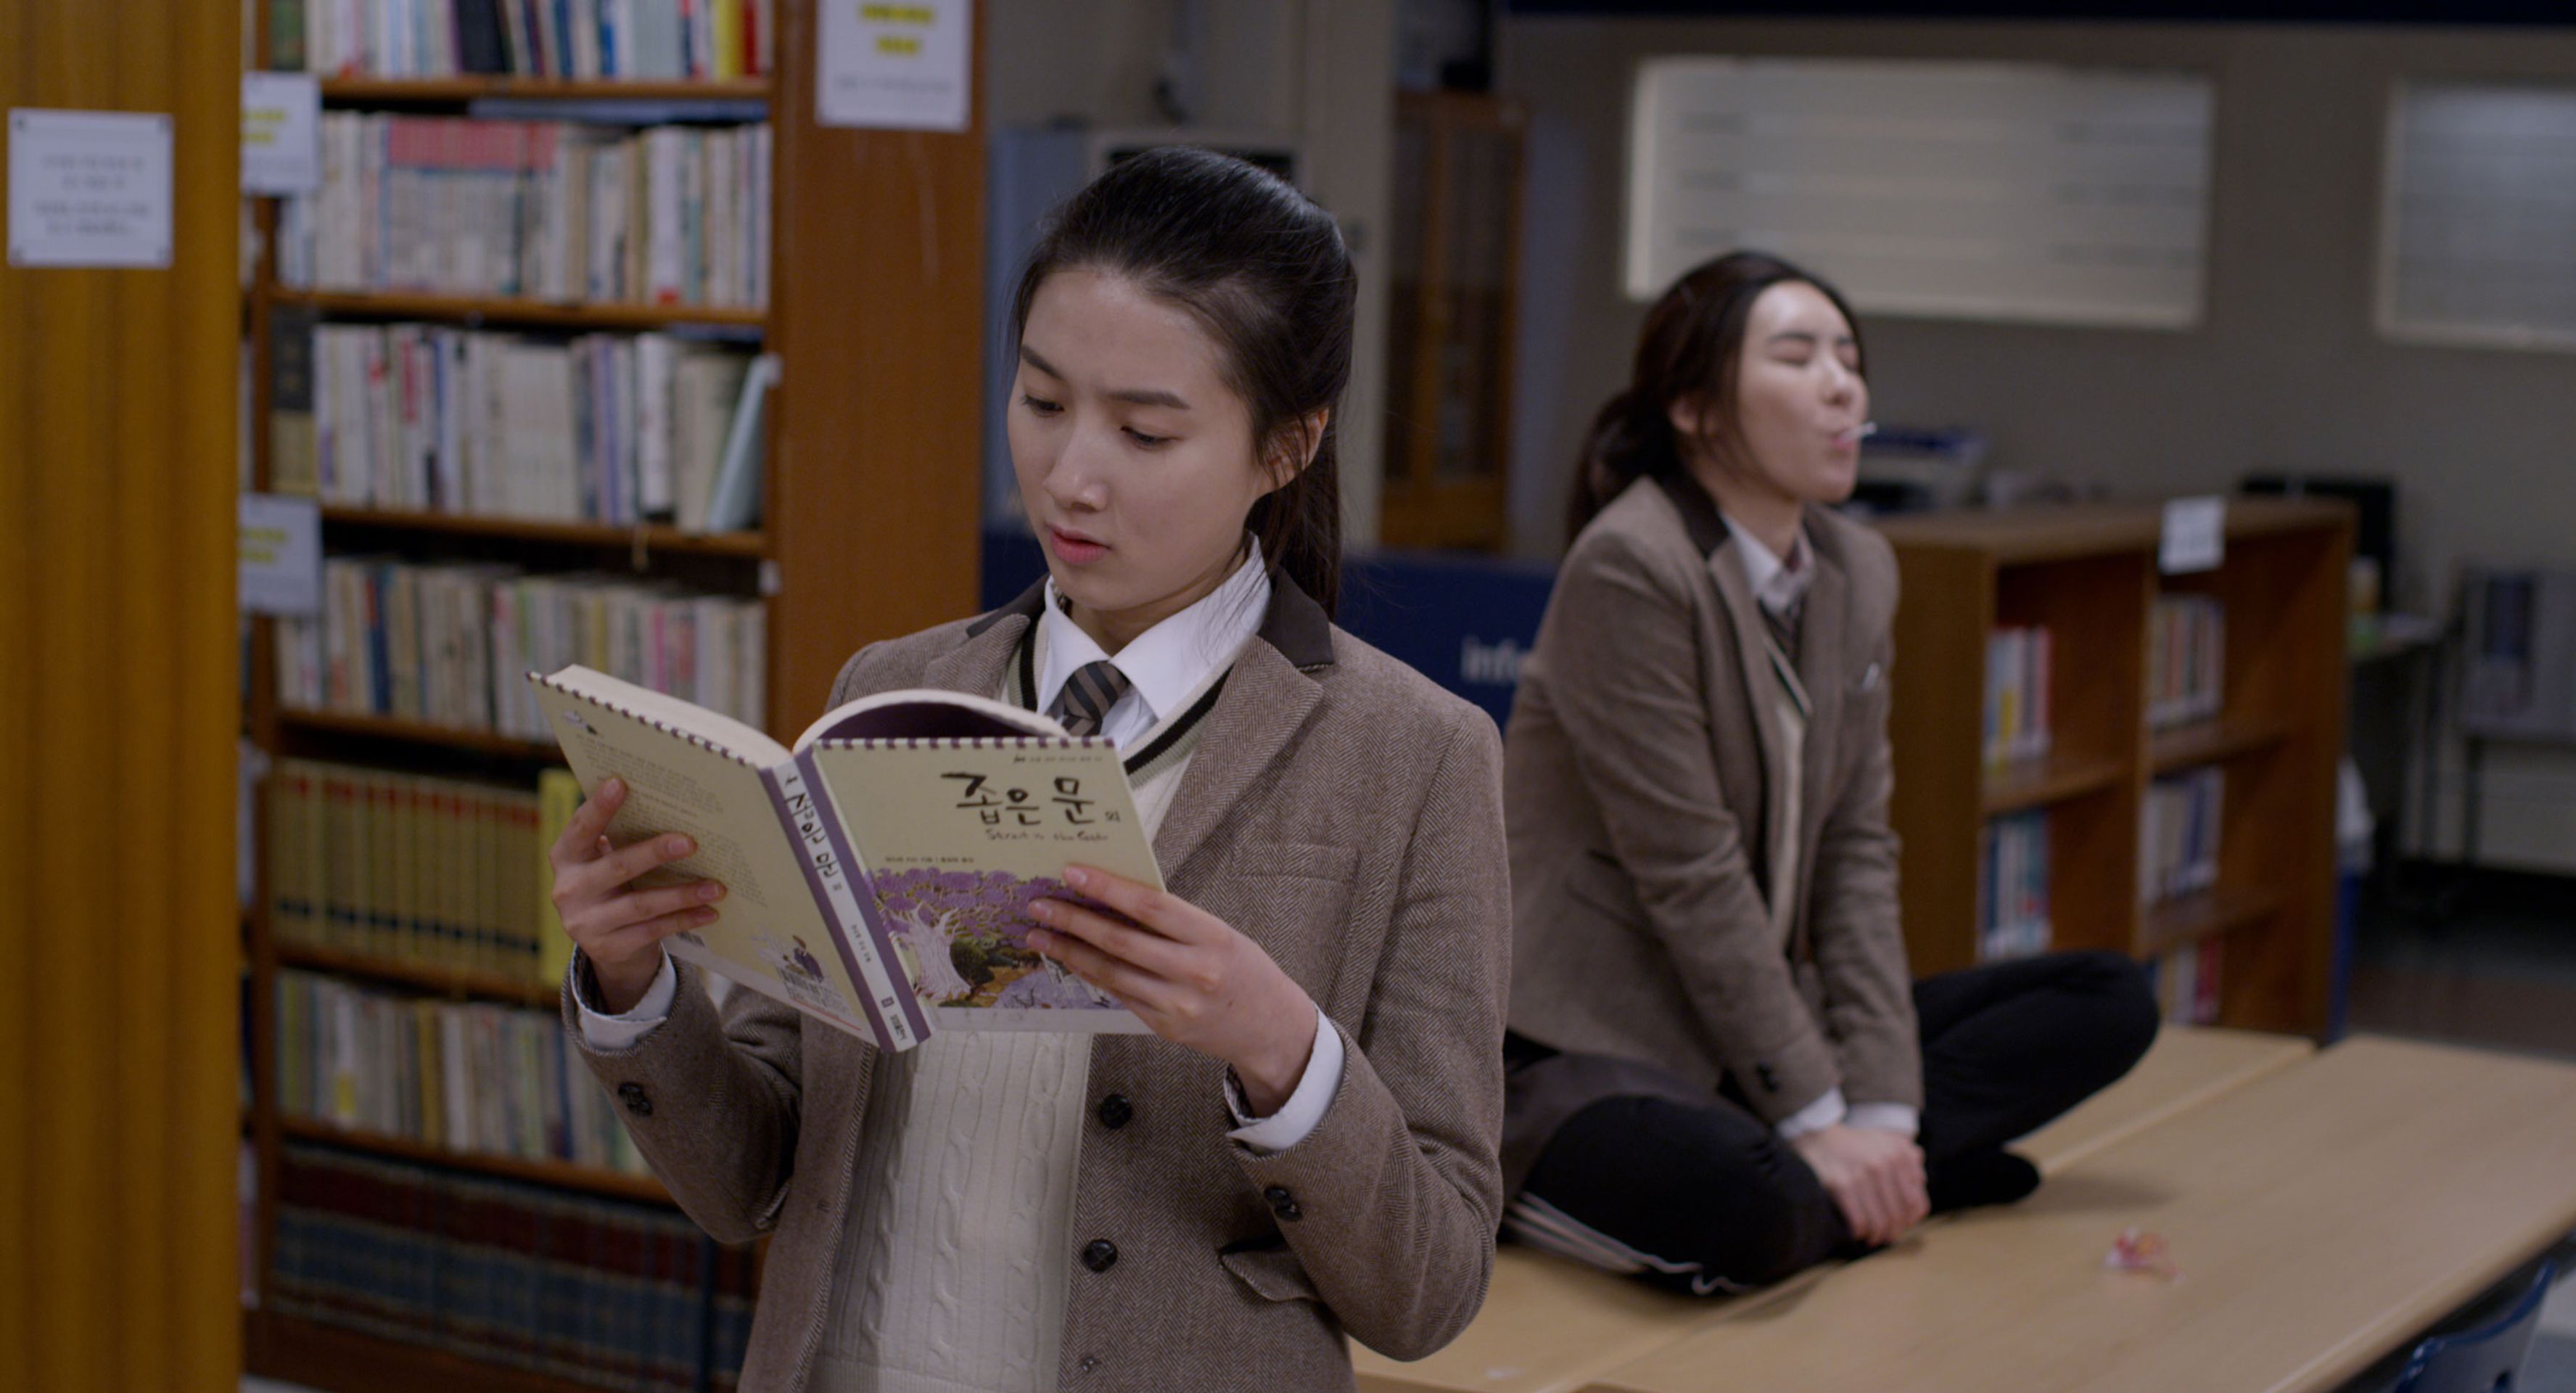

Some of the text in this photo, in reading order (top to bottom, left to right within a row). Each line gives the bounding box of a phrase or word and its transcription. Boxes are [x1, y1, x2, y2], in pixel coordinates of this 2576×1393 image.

[940, 772, 1041, 826] 좁은
[1052, 776, 1095, 825] 문
[783, 792, 828, 844] 좁은
[815, 852, 839, 878] 문
